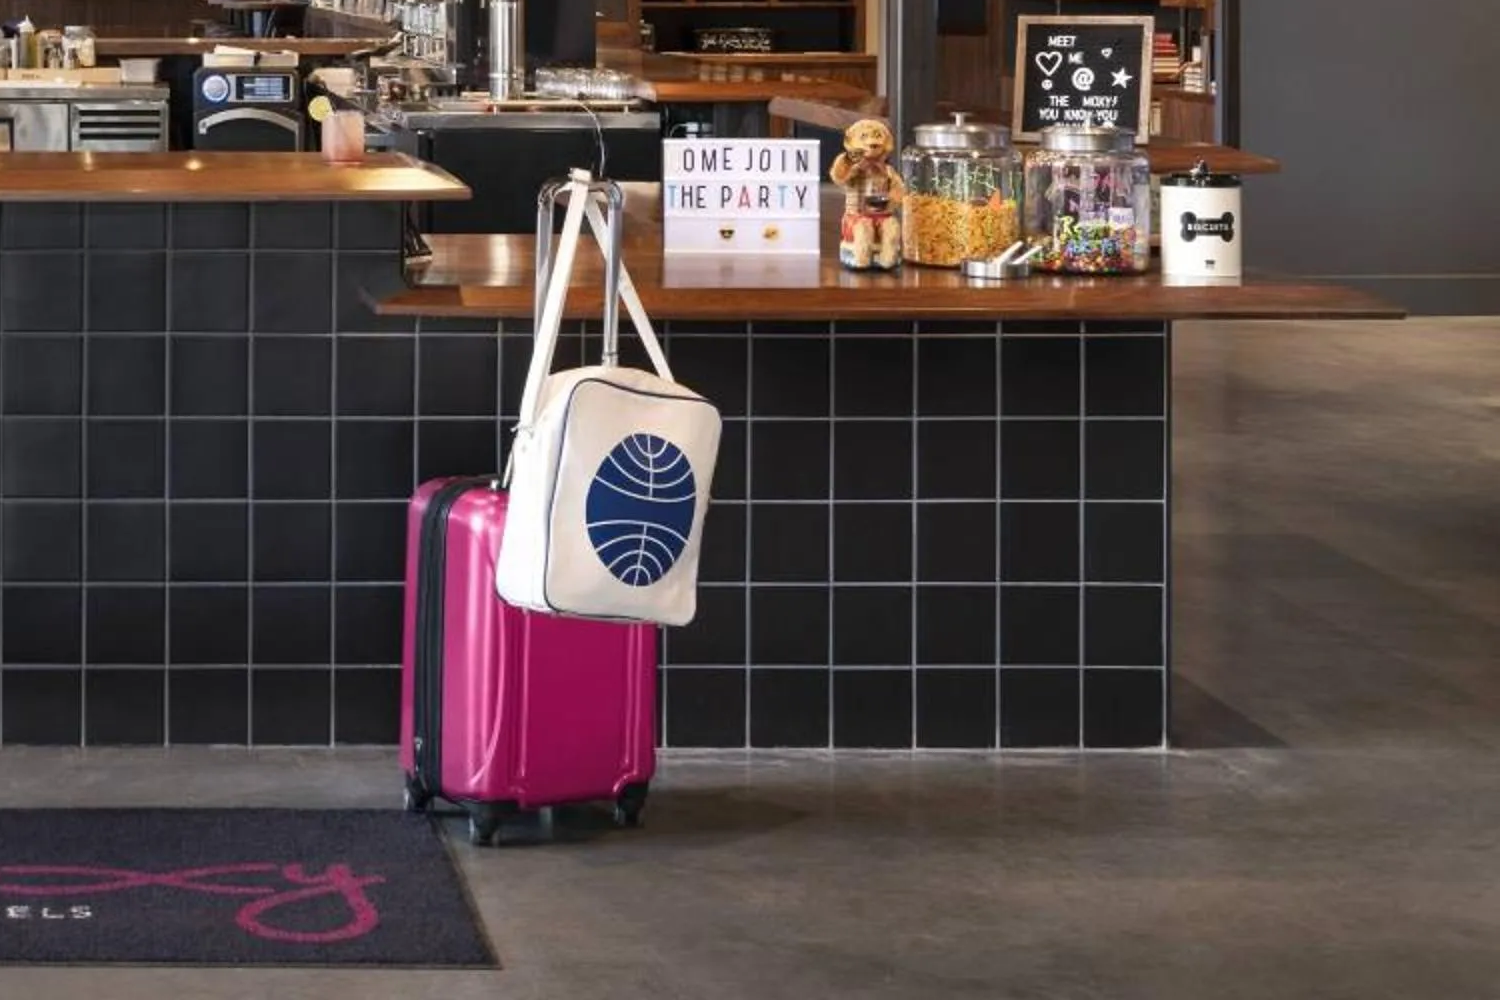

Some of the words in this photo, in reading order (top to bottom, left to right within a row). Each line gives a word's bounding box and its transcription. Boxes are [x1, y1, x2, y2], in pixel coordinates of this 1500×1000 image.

[1047, 35, 1077, 47] MEET
[1049, 95, 1070, 107] THE
[1039, 108, 1059, 120] YOU
[683, 147, 733, 172] OME
[744, 149, 809, 172] JOIN
[668, 185, 707, 208] THE
[721, 185, 808, 208] PARTY
